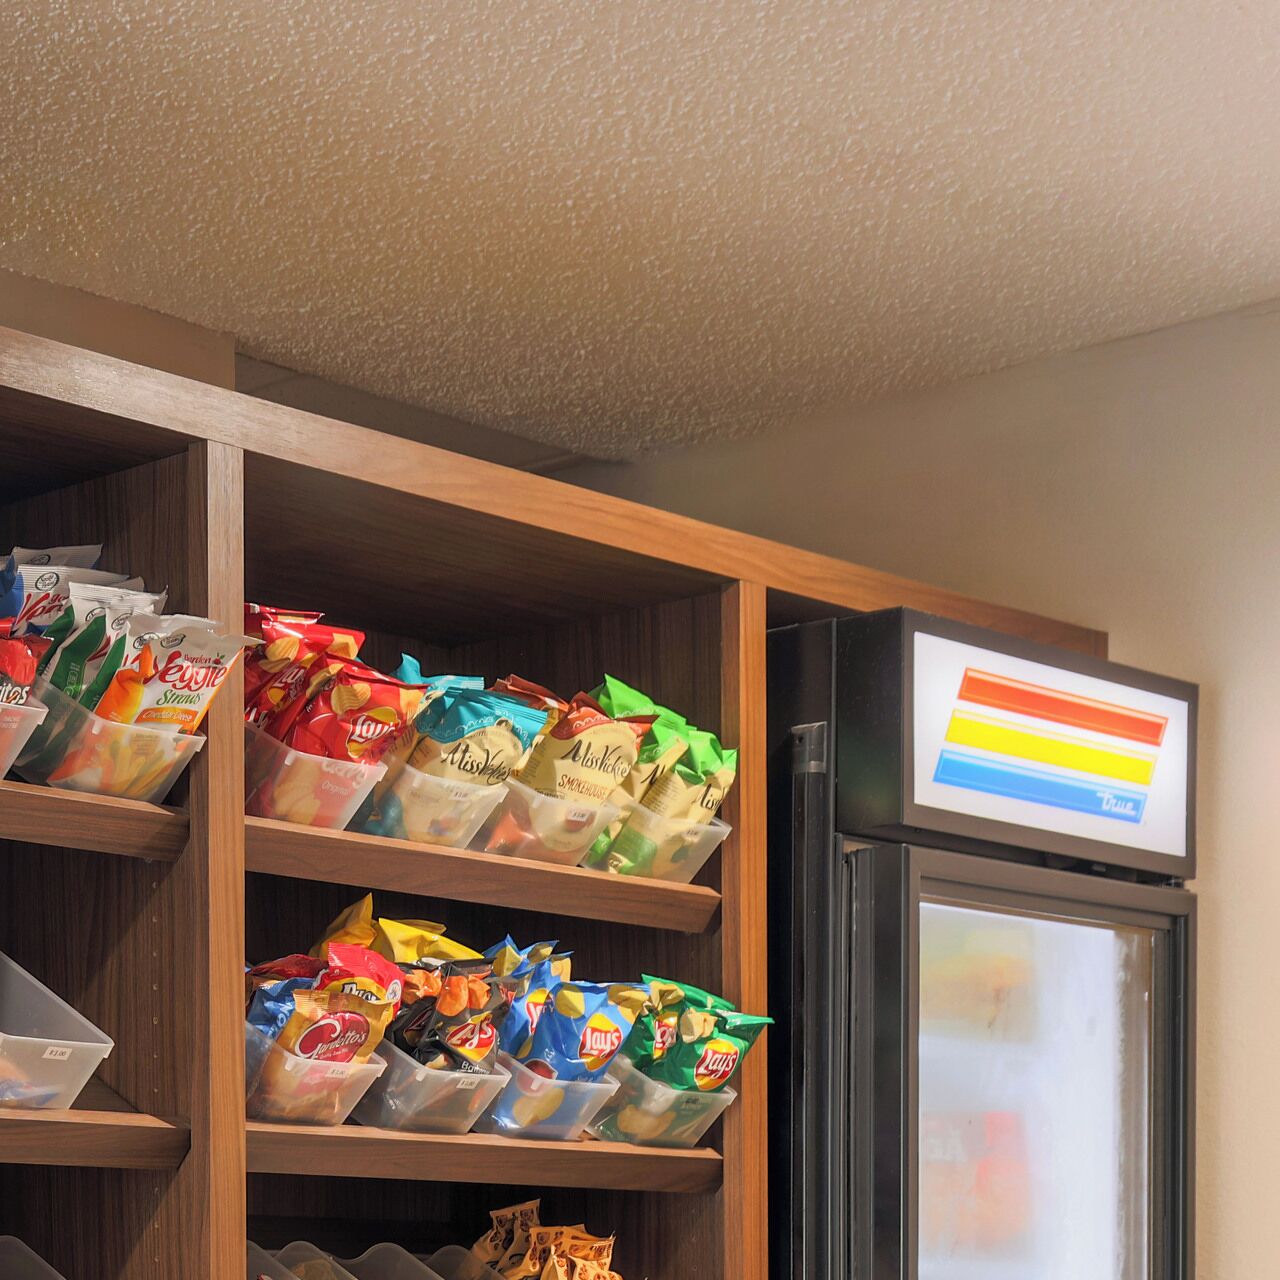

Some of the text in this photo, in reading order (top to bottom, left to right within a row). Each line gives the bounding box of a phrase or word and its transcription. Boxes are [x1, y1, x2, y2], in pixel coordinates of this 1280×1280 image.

[143, 650, 229, 692] Veggie
[1096, 791, 1137, 816] true
[583, 1028, 623, 1057] Lay's
[697, 1050, 738, 1079] Lay's
